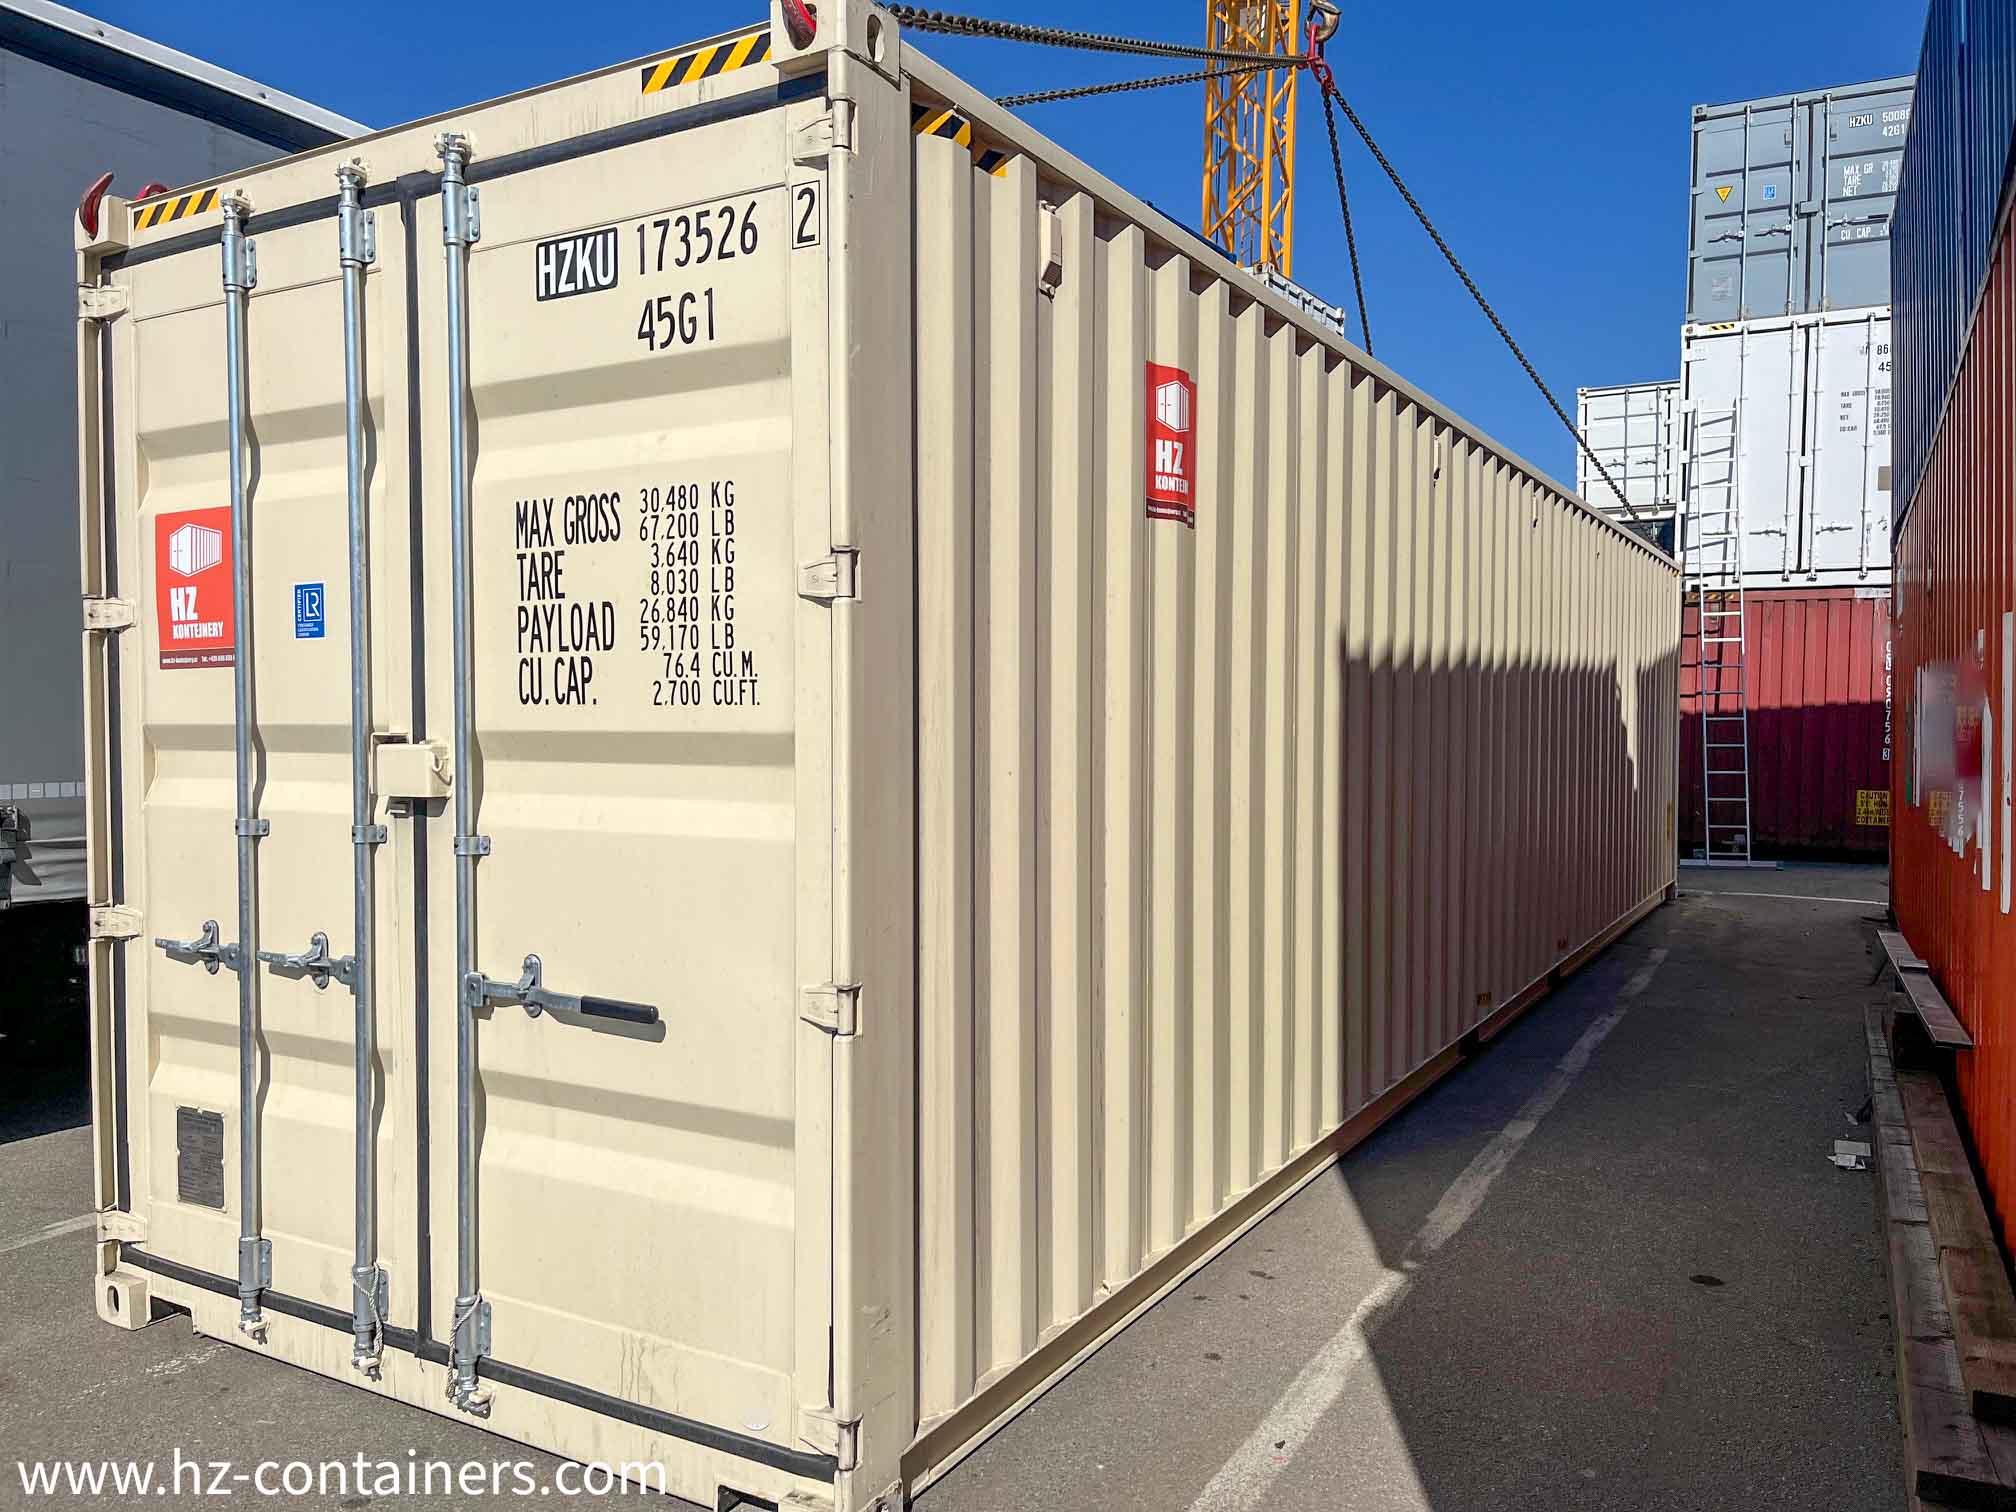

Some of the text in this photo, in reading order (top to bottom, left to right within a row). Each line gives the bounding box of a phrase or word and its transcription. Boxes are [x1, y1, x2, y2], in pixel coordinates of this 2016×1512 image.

[1849, 114, 1873, 127] HZKU
[1842, 185, 1857, 197] NET
[538, 187, 817, 298] HZKU 173526 2
[637, 287, 716, 351] 45G1
[1155, 438, 1184, 476] HZ
[515, 480, 736, 550] MAX GROSS 30,480 KG
[639, 509, 735, 542] 67,200 LB
[516, 538, 736, 602] TARE 3,640 KG
[650, 566, 735, 596] 8,030 LB
[169, 586, 199, 622] HZ
[305, 591, 320, 617] LR
[172, 621, 224, 641] KONTEJNERY
[517, 594, 736, 654] PAYLOAD 26,840 KG
[640, 623, 735, 652] 59,170 LB
[663, 652, 701, 679] 76.4
[652, 680, 702, 706] 2,700
